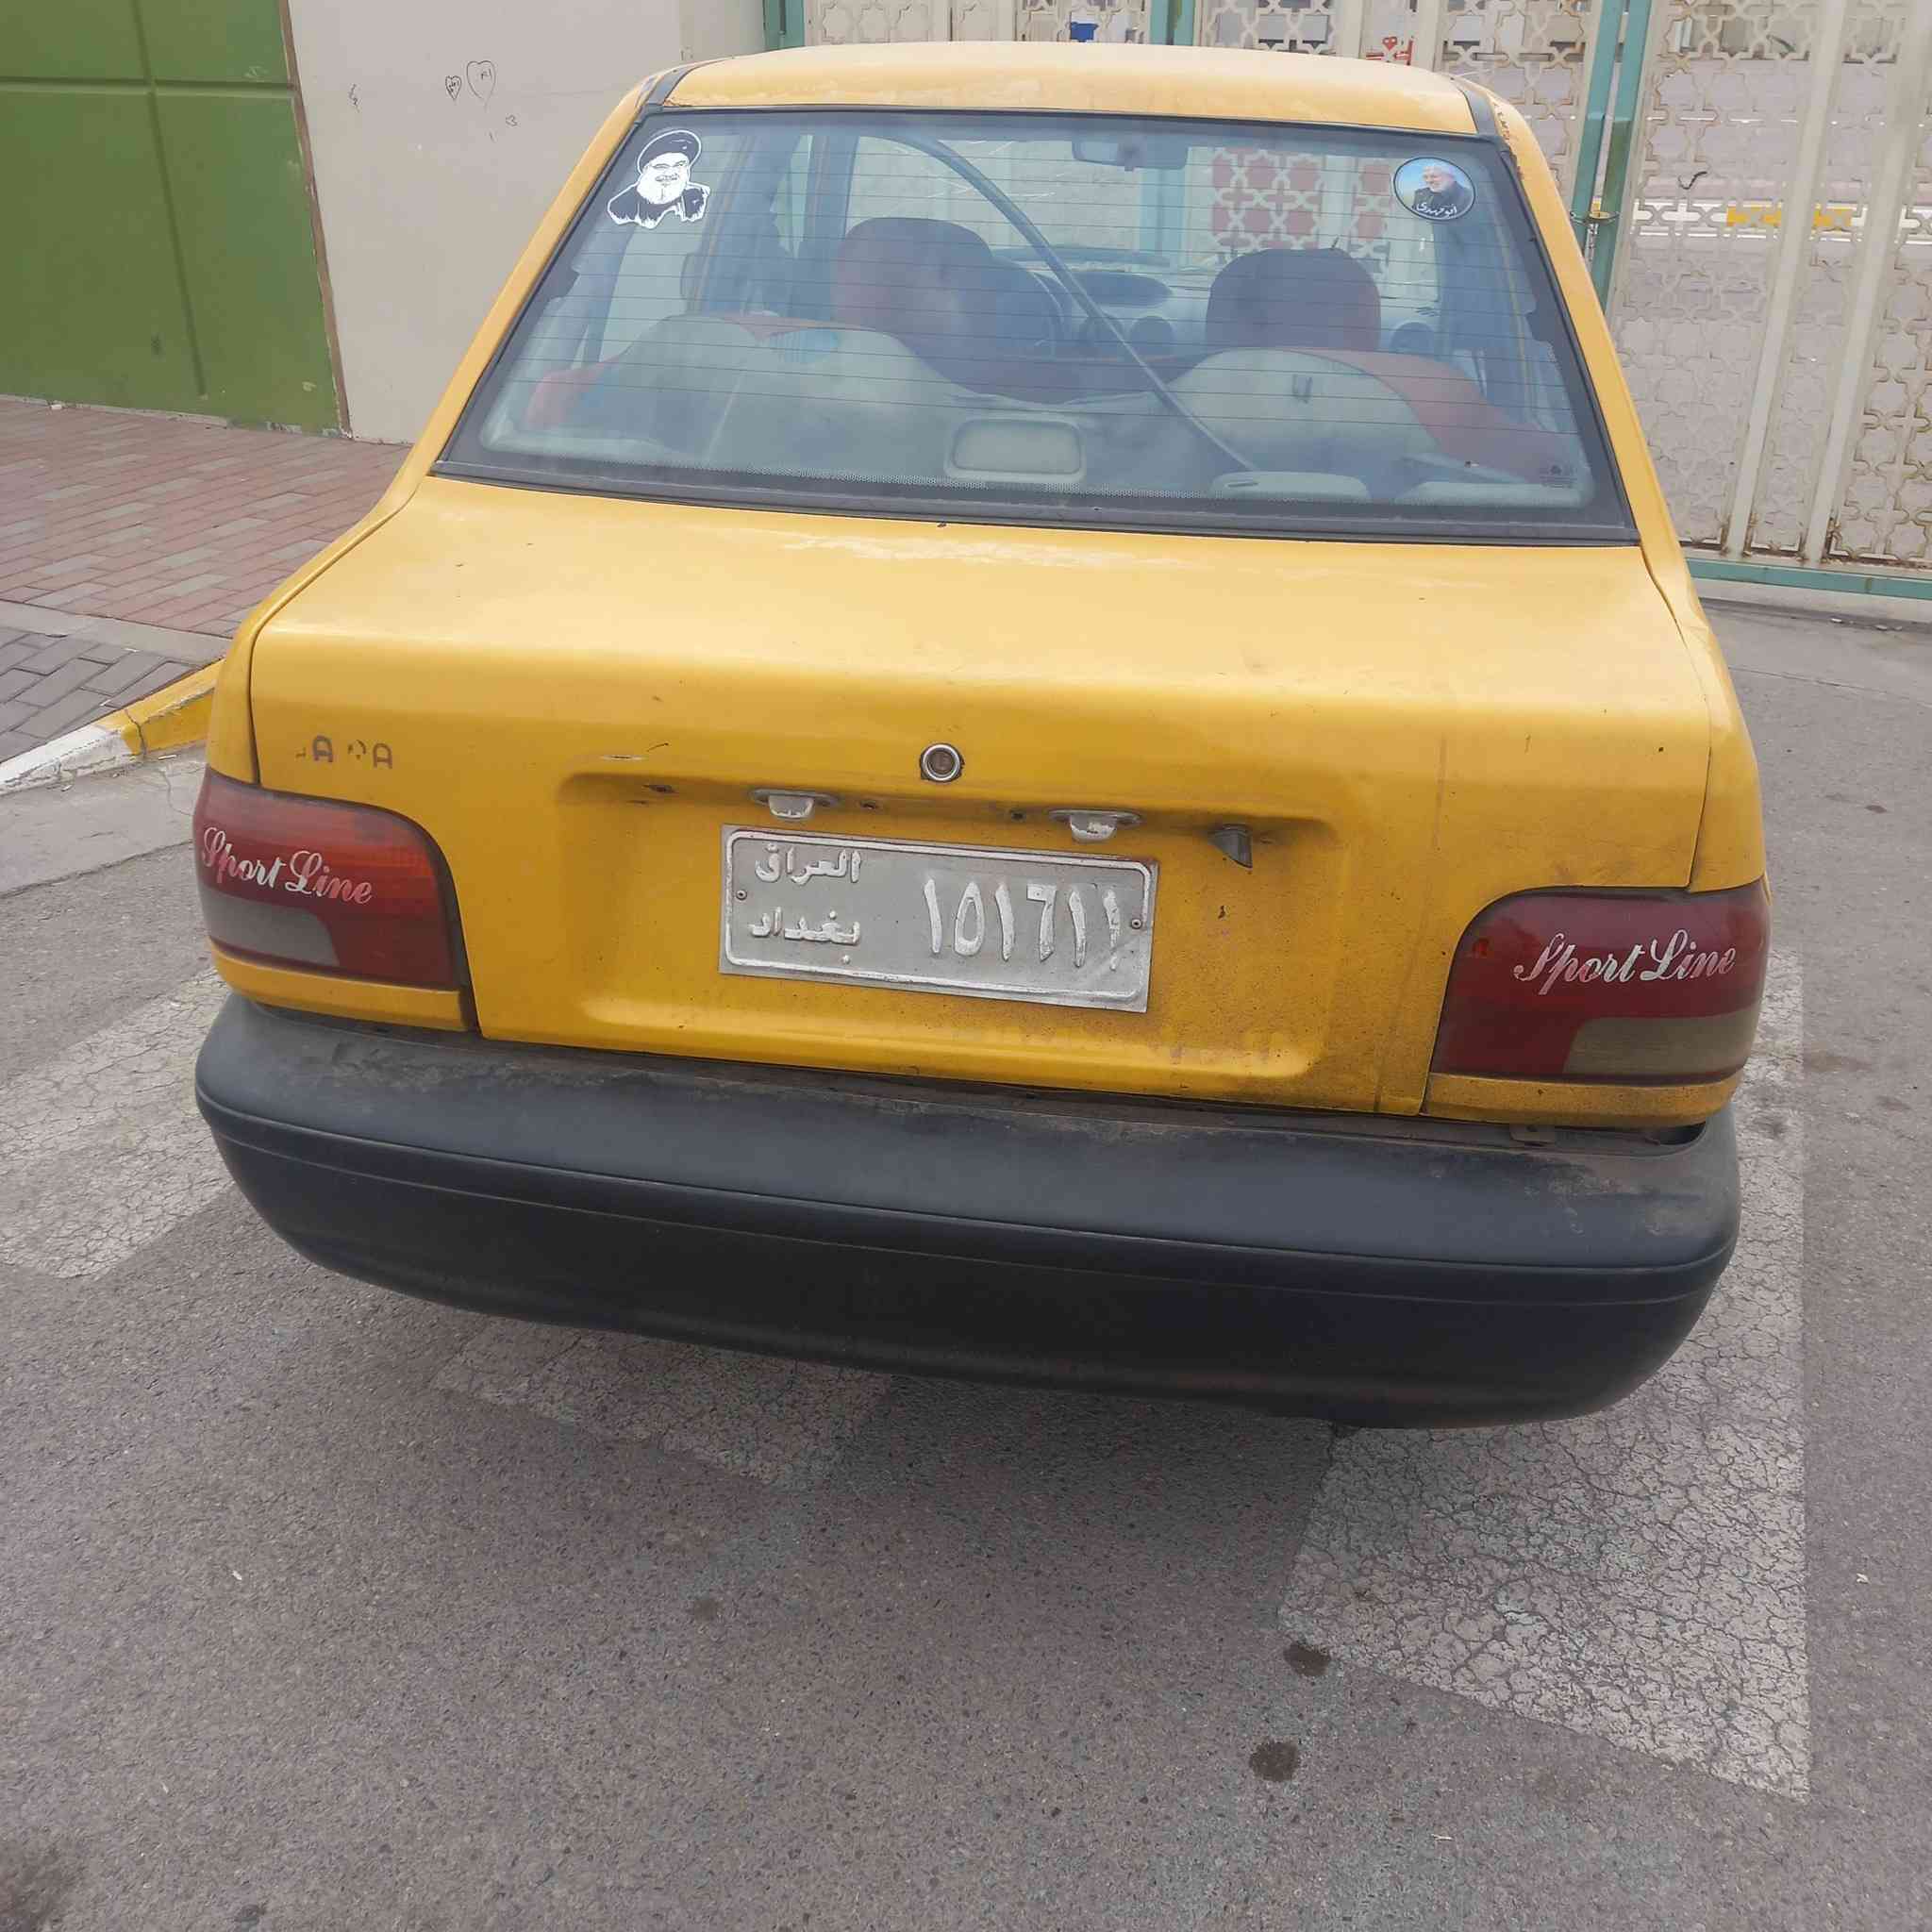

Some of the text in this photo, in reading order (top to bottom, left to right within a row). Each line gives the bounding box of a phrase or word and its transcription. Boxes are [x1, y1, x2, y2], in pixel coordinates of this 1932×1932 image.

[202, 826, 375, 905] Sport Line
[754, 842, 862, 885] العراق
[748, 906, 861, 964] بغداد
[1513, 929, 1737, 996] Sport Line
